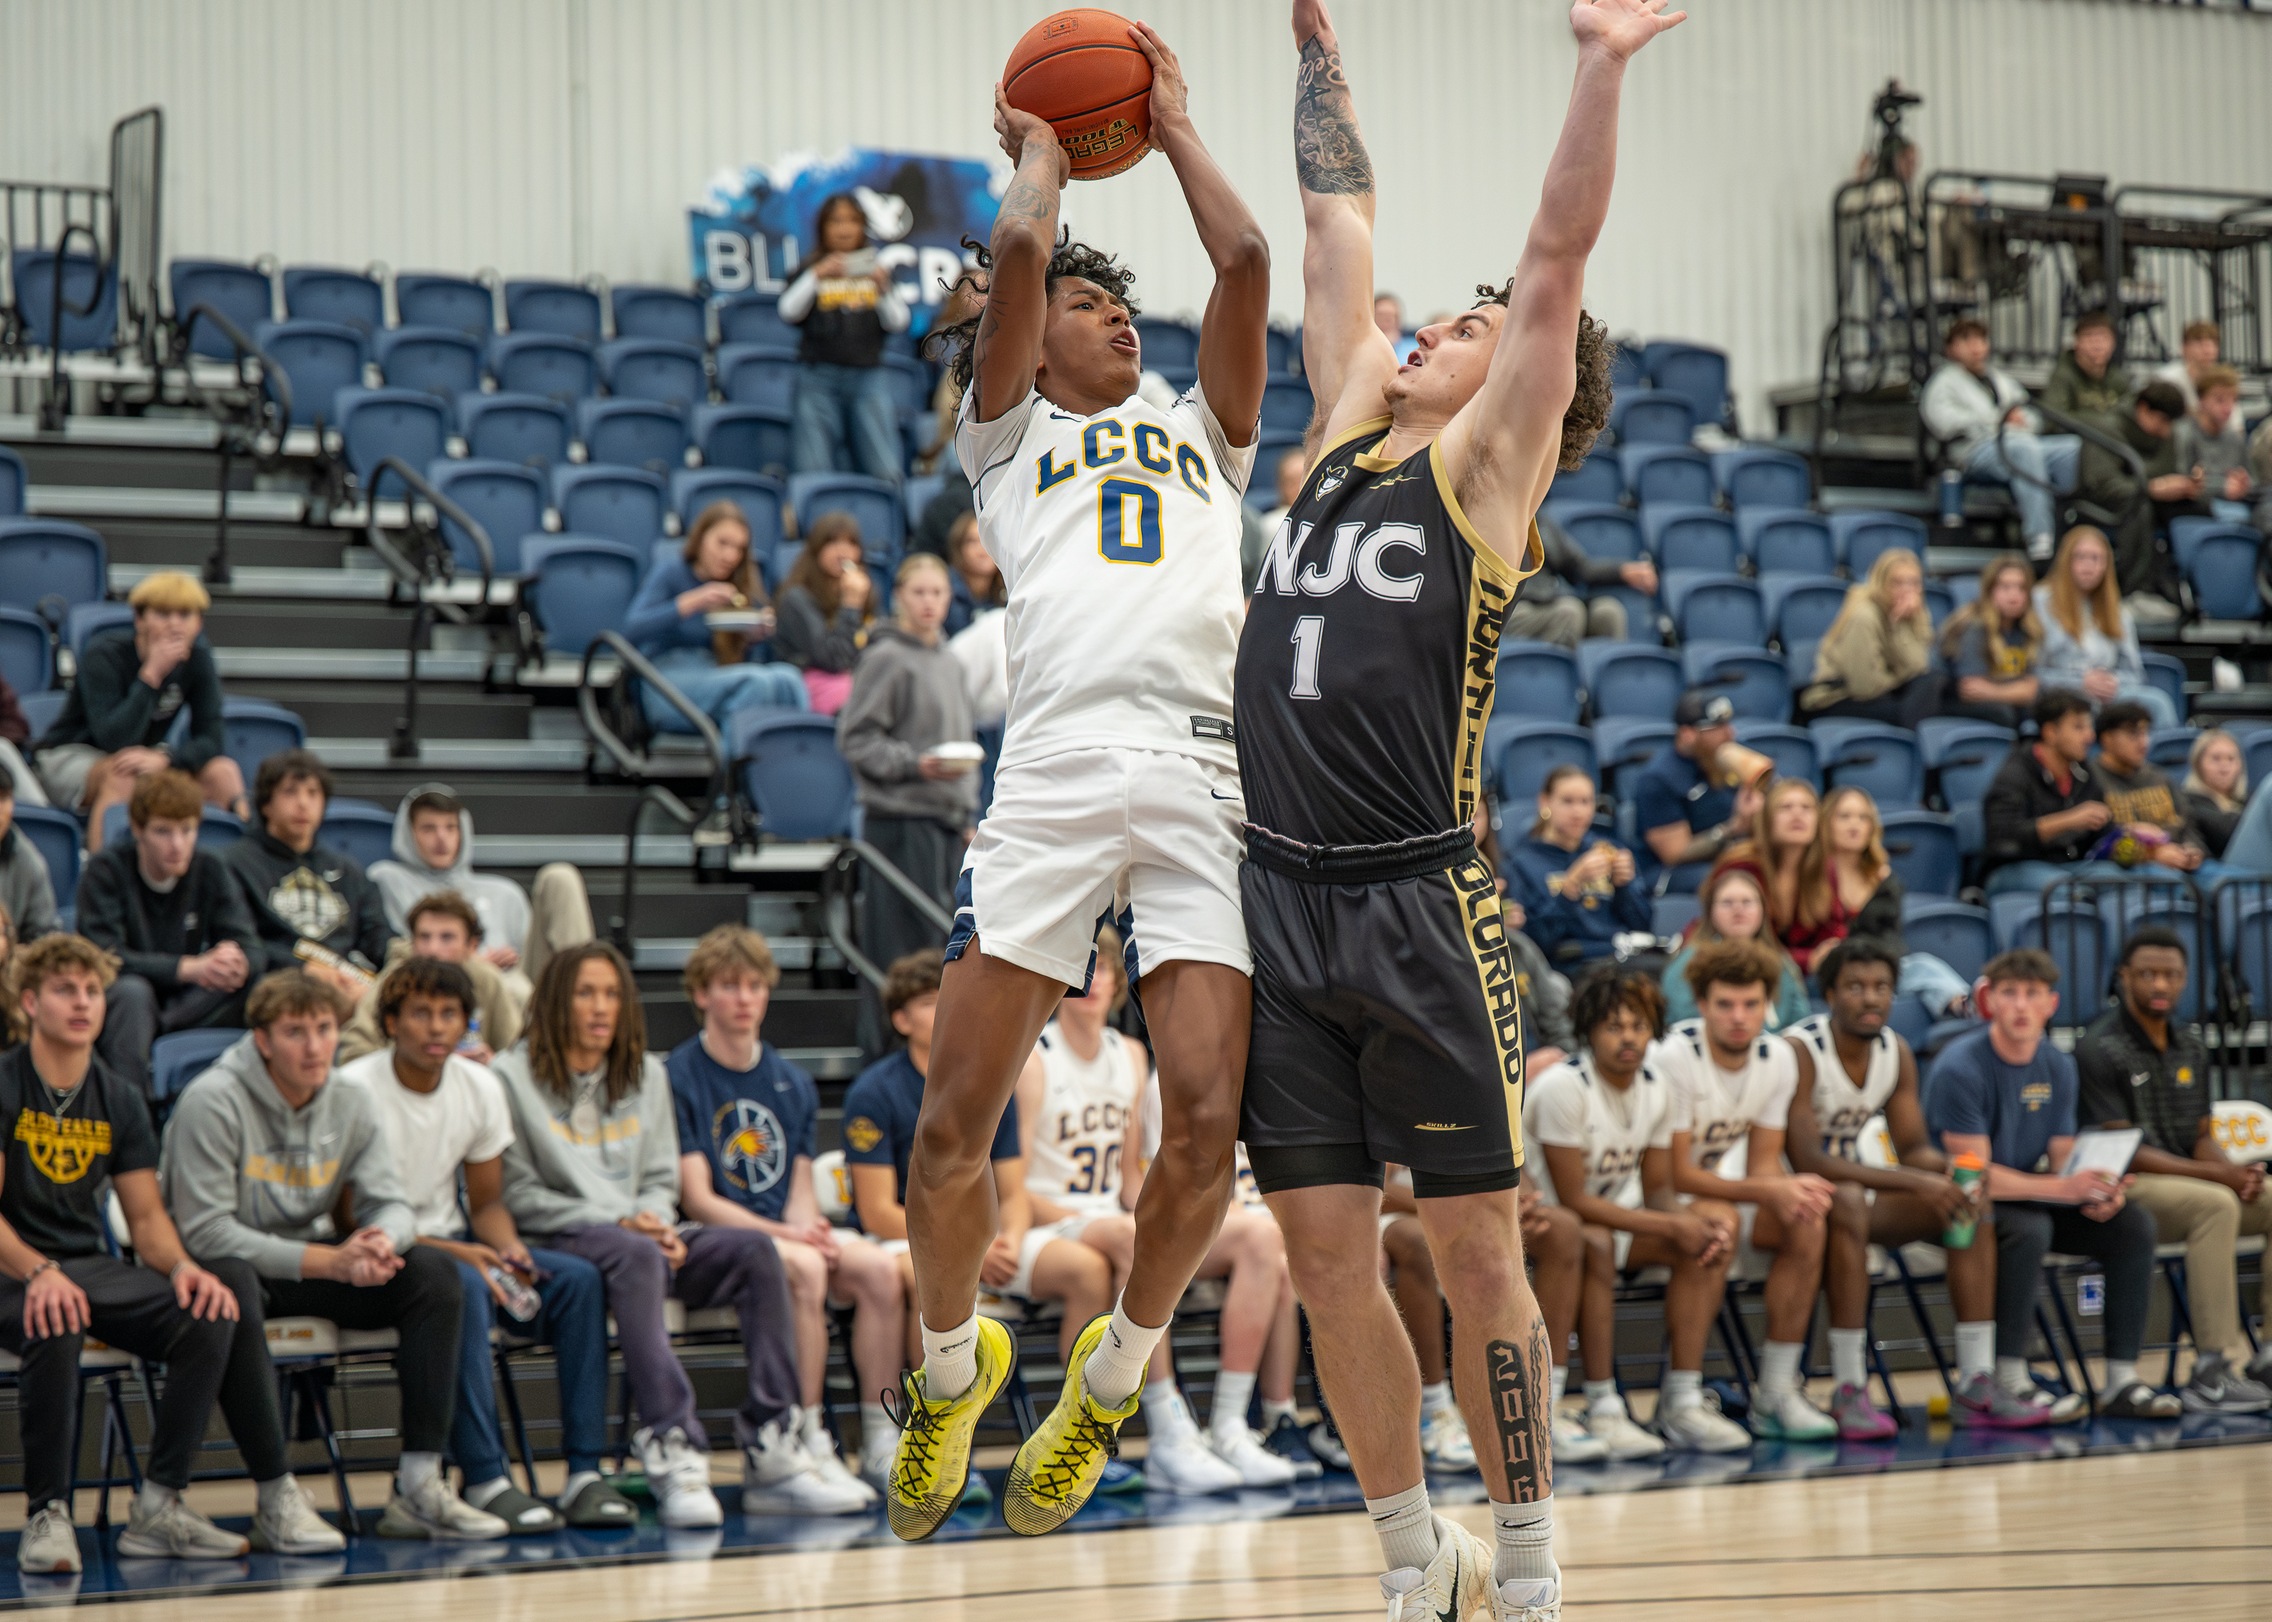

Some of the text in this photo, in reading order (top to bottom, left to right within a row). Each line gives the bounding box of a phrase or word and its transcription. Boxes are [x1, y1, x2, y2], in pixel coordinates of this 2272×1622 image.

[1064, 123, 1139, 159] LEGAC
[1036, 417, 1213, 505] LCCC
[1097, 475, 1165, 567] 0
[1254, 516, 1426, 603] NJC
[1289, 615, 1325, 700] 1
[1226, 726, 1234, 736] S
[1452, 861, 1521, 1085] OLORADO
[1068, 1144, 1121, 1193] 30
[1493, 1345, 1535, 1504] 2006
